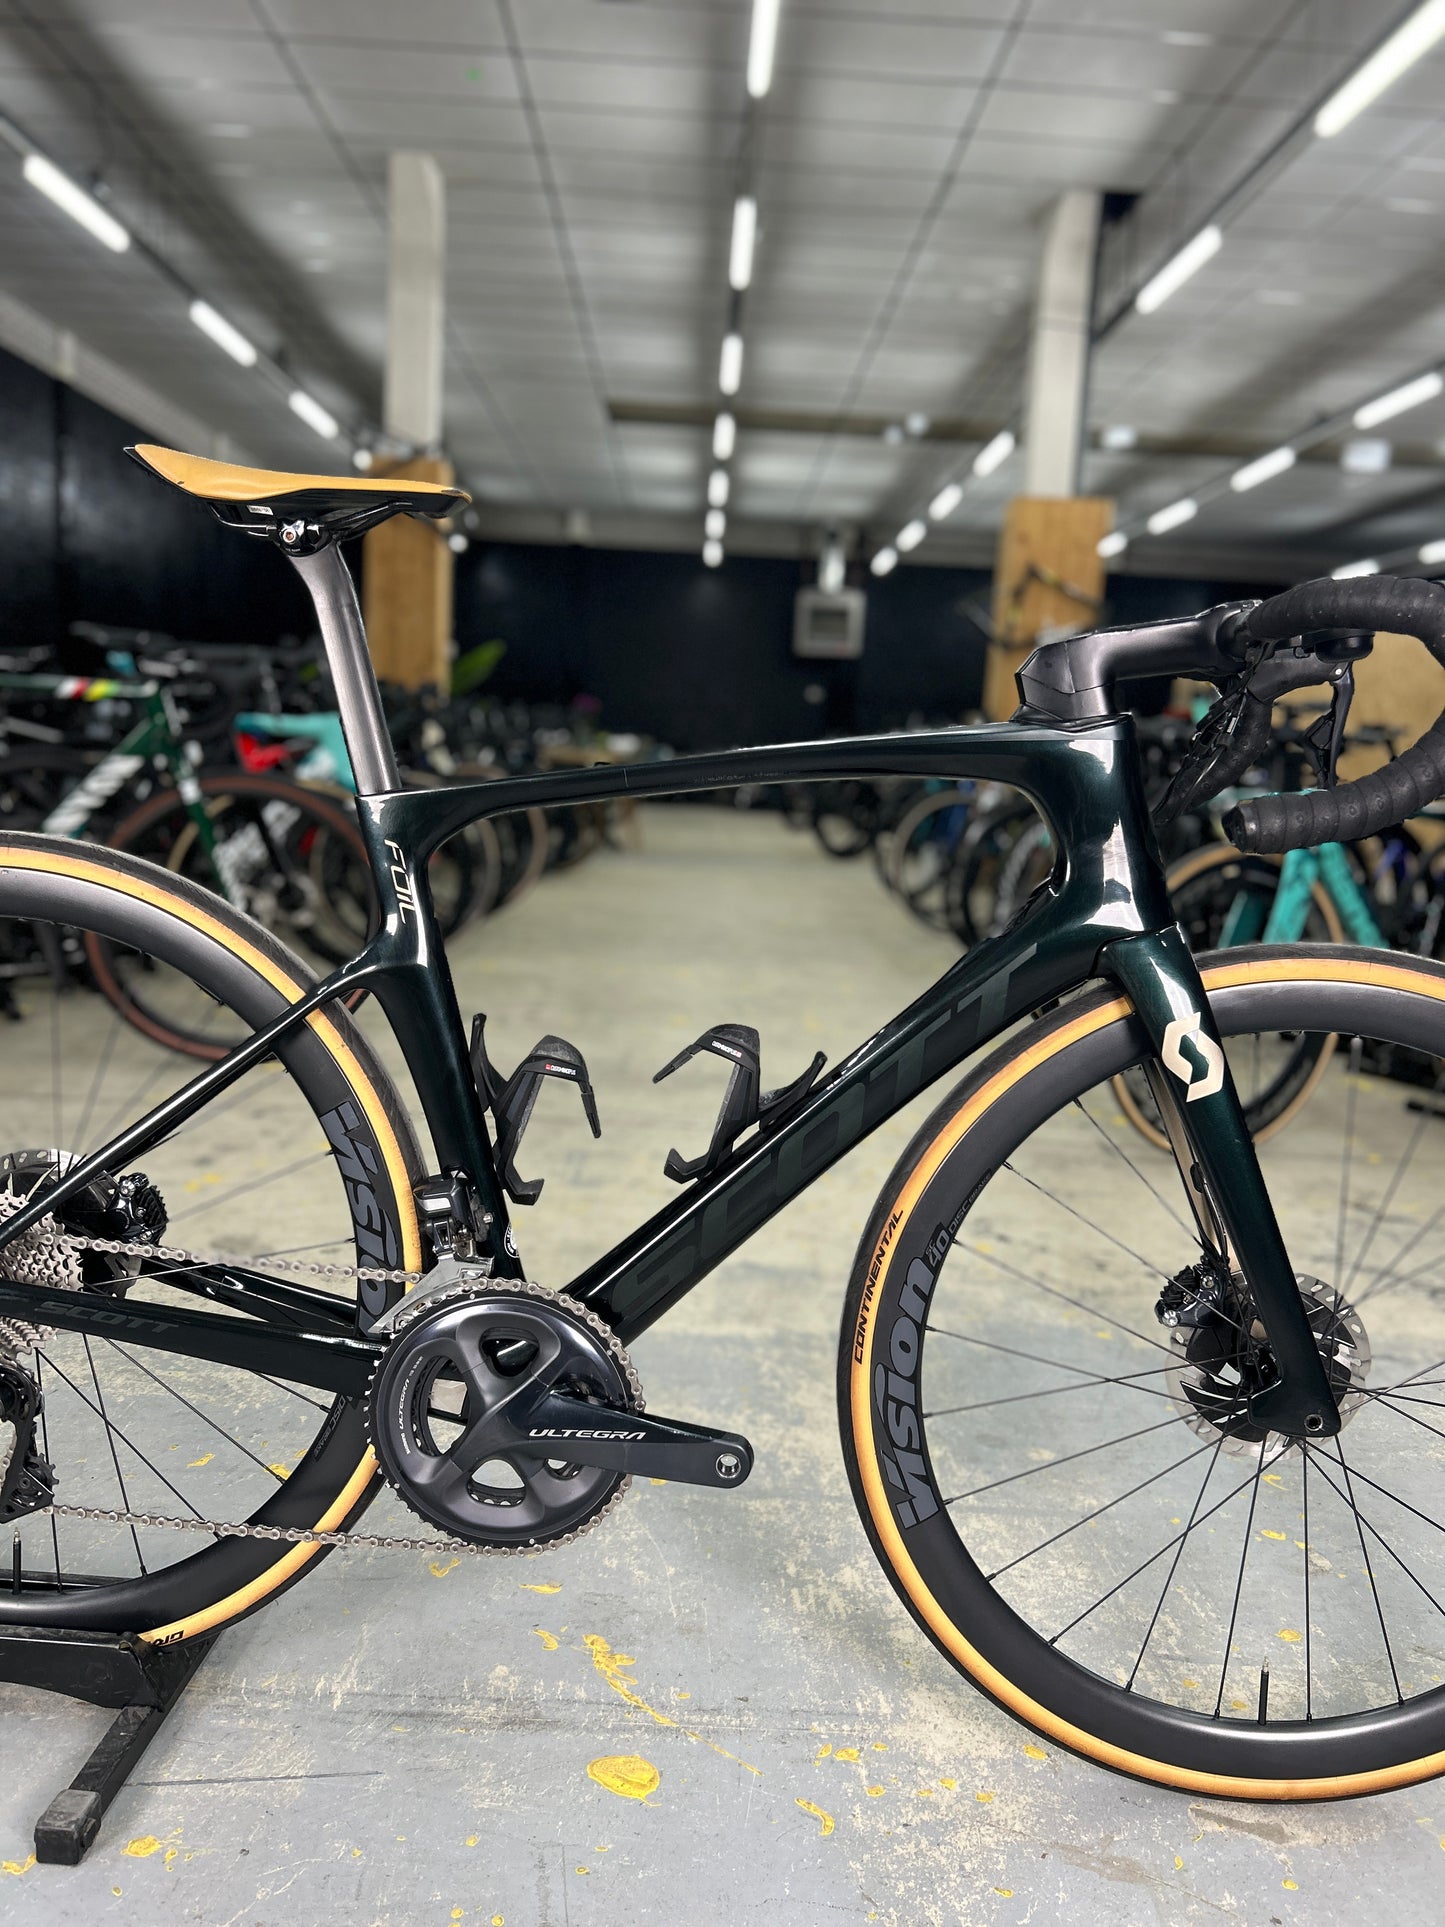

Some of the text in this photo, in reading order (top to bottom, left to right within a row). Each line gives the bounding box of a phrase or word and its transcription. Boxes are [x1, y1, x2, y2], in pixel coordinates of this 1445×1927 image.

[384, 839, 415, 924] FOIL
[611, 942, 1039, 1322] SCOTT
[928, 1229, 950, 1267] 40
[854, 1210, 903, 1364] CONTINENTAL
[34, 1301, 179, 1333] SCOTT
[398, 1378, 410, 1430] ULTEGRA
[529, 1428, 646, 1440] ULTEGRA
